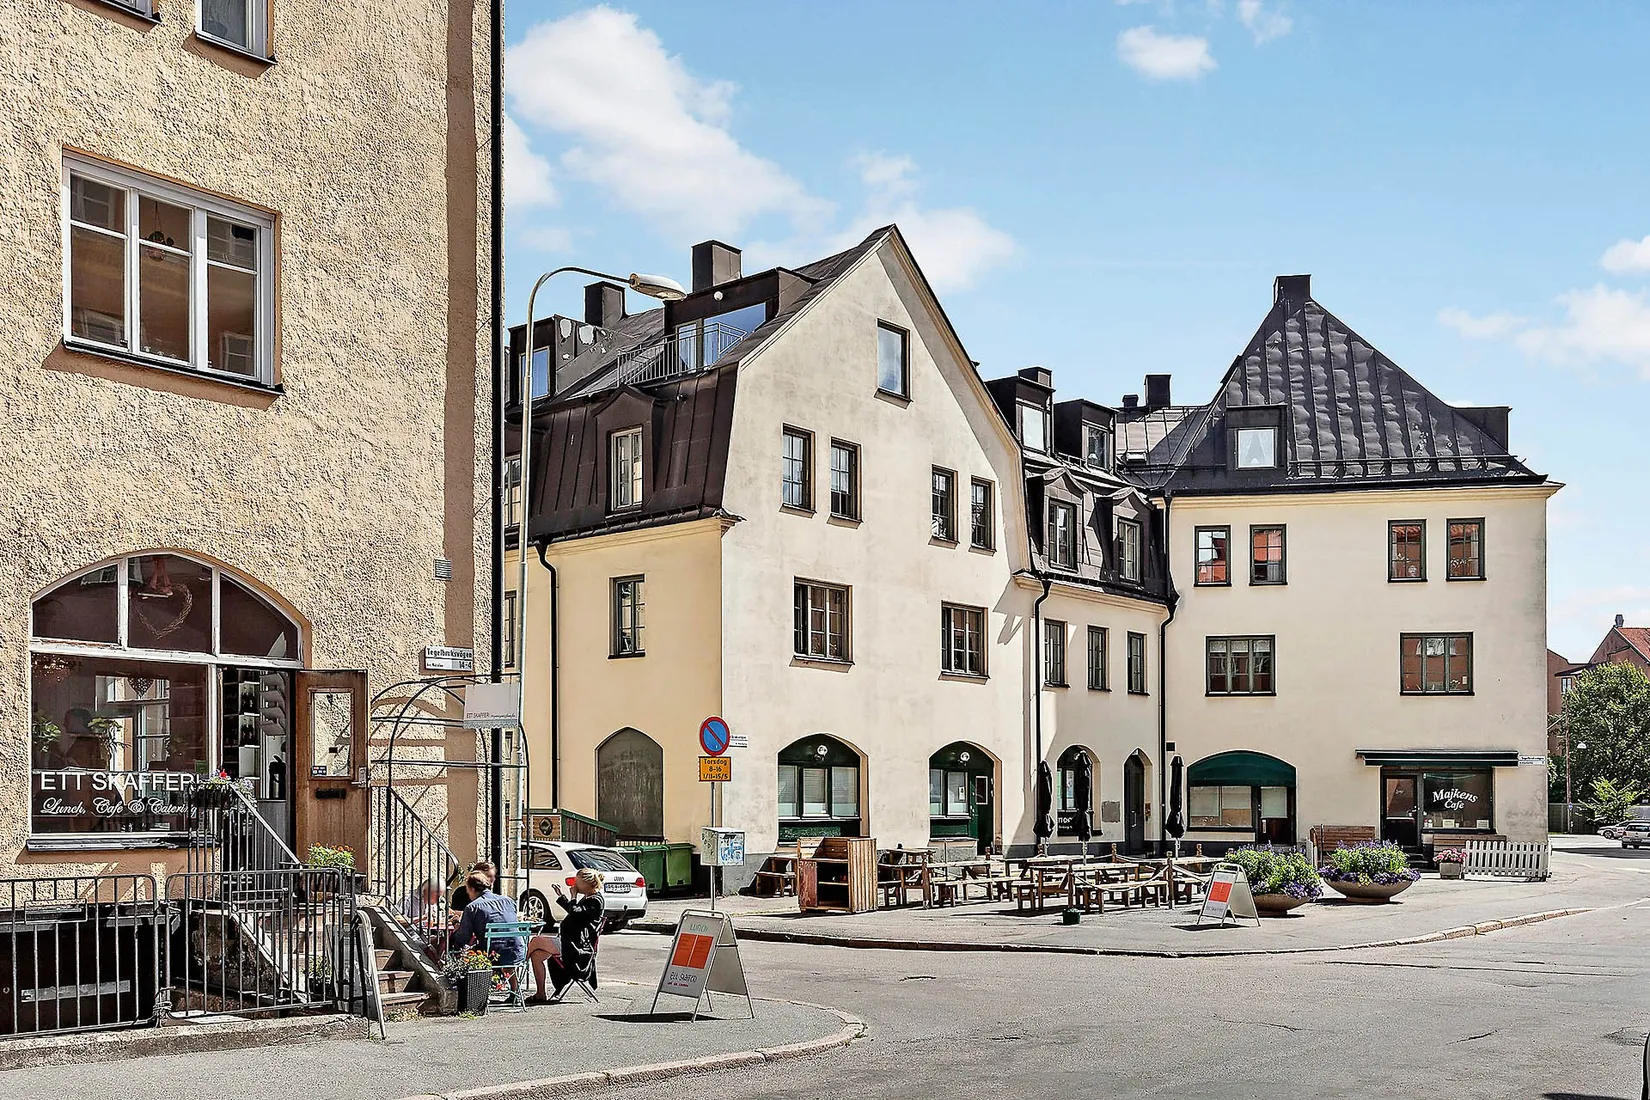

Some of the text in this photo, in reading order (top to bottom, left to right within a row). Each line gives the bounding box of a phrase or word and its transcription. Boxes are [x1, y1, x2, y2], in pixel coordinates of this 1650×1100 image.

[40, 772, 86, 790] ETT
[1432, 788, 1478, 803] Majkens
[40, 798, 87, 815] Lunch,
[1444, 800, 1465, 810] Cafe
